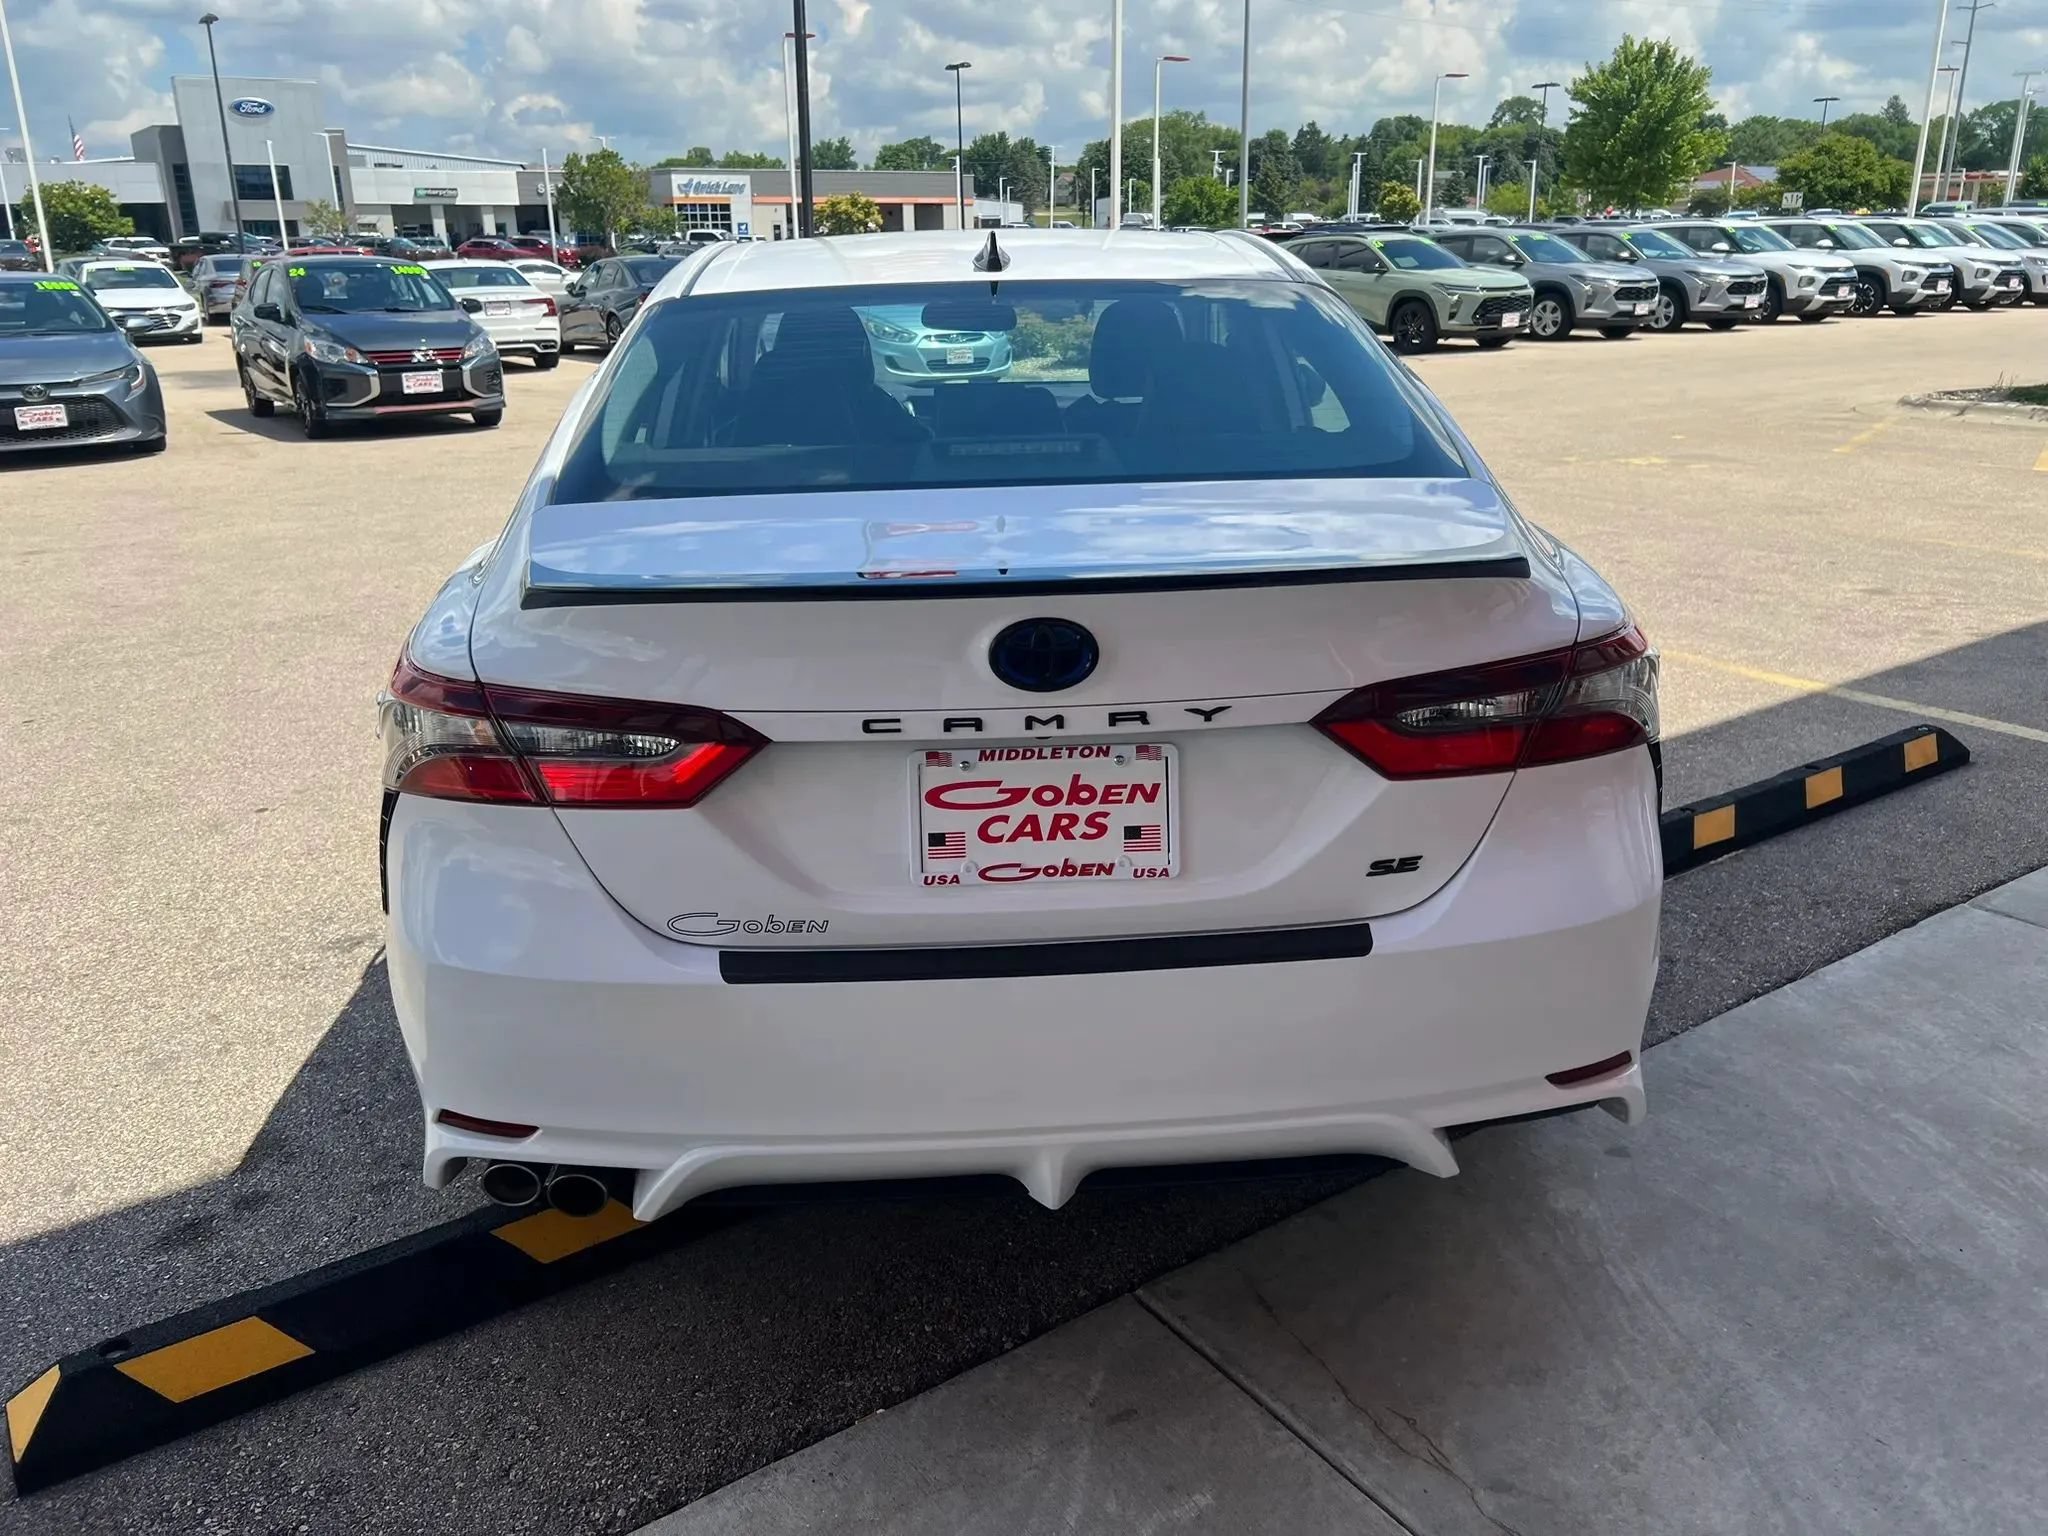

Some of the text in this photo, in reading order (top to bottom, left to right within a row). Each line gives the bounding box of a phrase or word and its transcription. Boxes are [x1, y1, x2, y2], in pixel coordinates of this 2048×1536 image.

[240, 102, 265, 113] Ford
[693, 180, 746, 195] Quick Lane
[289, 268, 306, 277] 24
[862, 705, 1233, 734] CAMRY
[978, 745, 1111, 762] MIDDLETON
[976, 811, 1112, 844] CARS
[1366, 855, 1423, 877] SE
[923, 874, 961, 886] USA
[1132, 867, 1170, 879] USA
